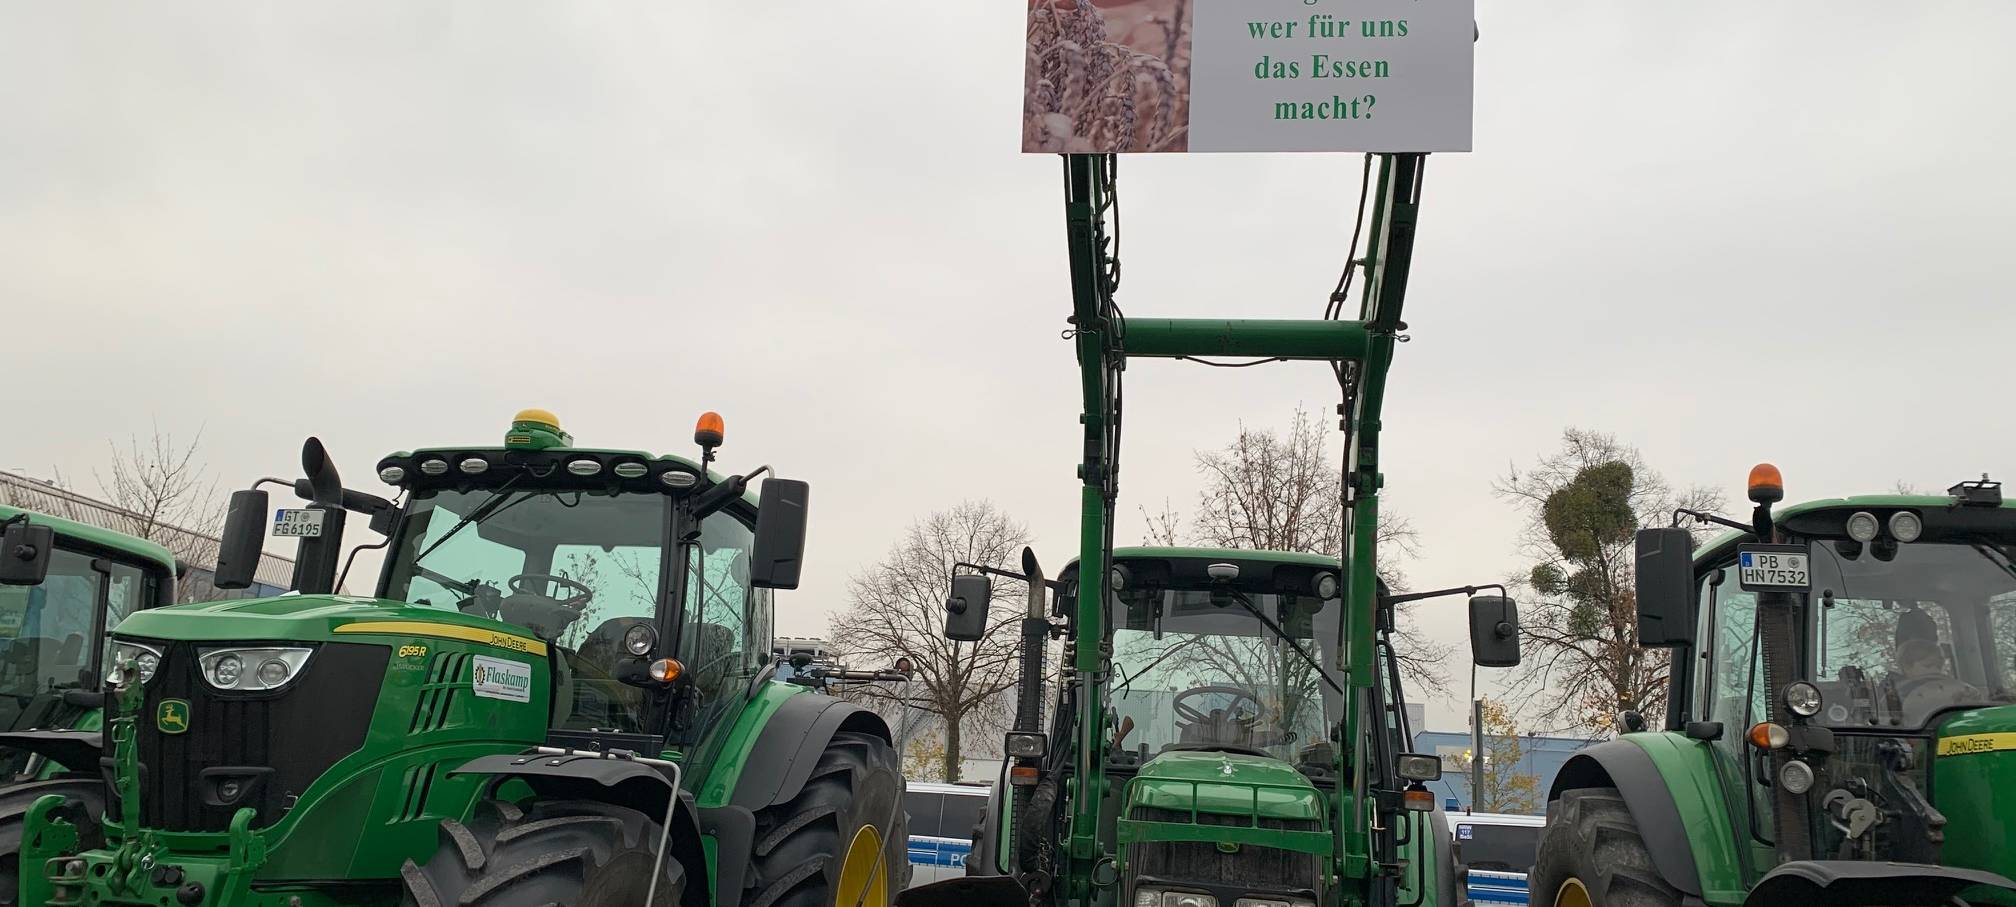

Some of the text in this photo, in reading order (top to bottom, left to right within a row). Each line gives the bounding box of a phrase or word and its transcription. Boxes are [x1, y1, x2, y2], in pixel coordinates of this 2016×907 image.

[1248, 14, 1408, 39] wer für uns
[1254, 54, 1390, 79] das Essen
[1274, 94, 1376, 119] macht?
[285, 511, 300, 522] GT
[1759, 555, 1779, 569] PB
[486, 666, 529, 692] Flaskamp
